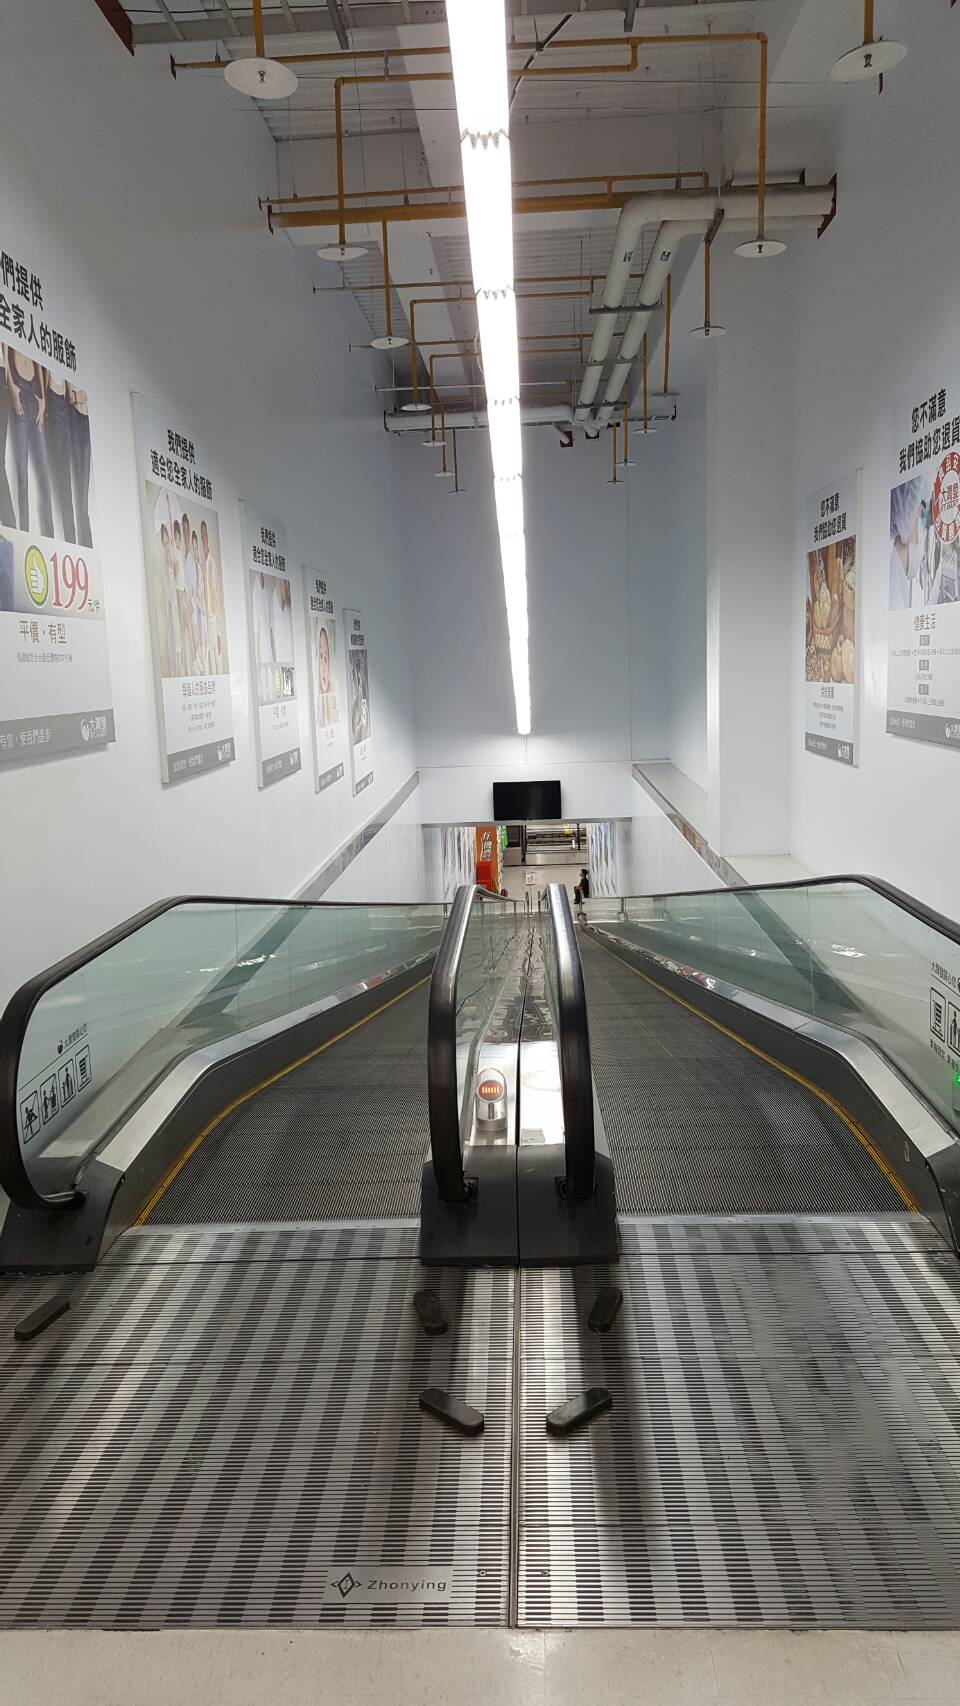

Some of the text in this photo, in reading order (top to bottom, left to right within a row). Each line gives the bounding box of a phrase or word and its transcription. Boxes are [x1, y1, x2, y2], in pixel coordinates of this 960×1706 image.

[911, 388, 947, 434] 您不滿意
[167, 429, 196, 466] 我們提供
[49, 551, 89, 611] 199
[367, 1579, 448, 1592] Zhonying
